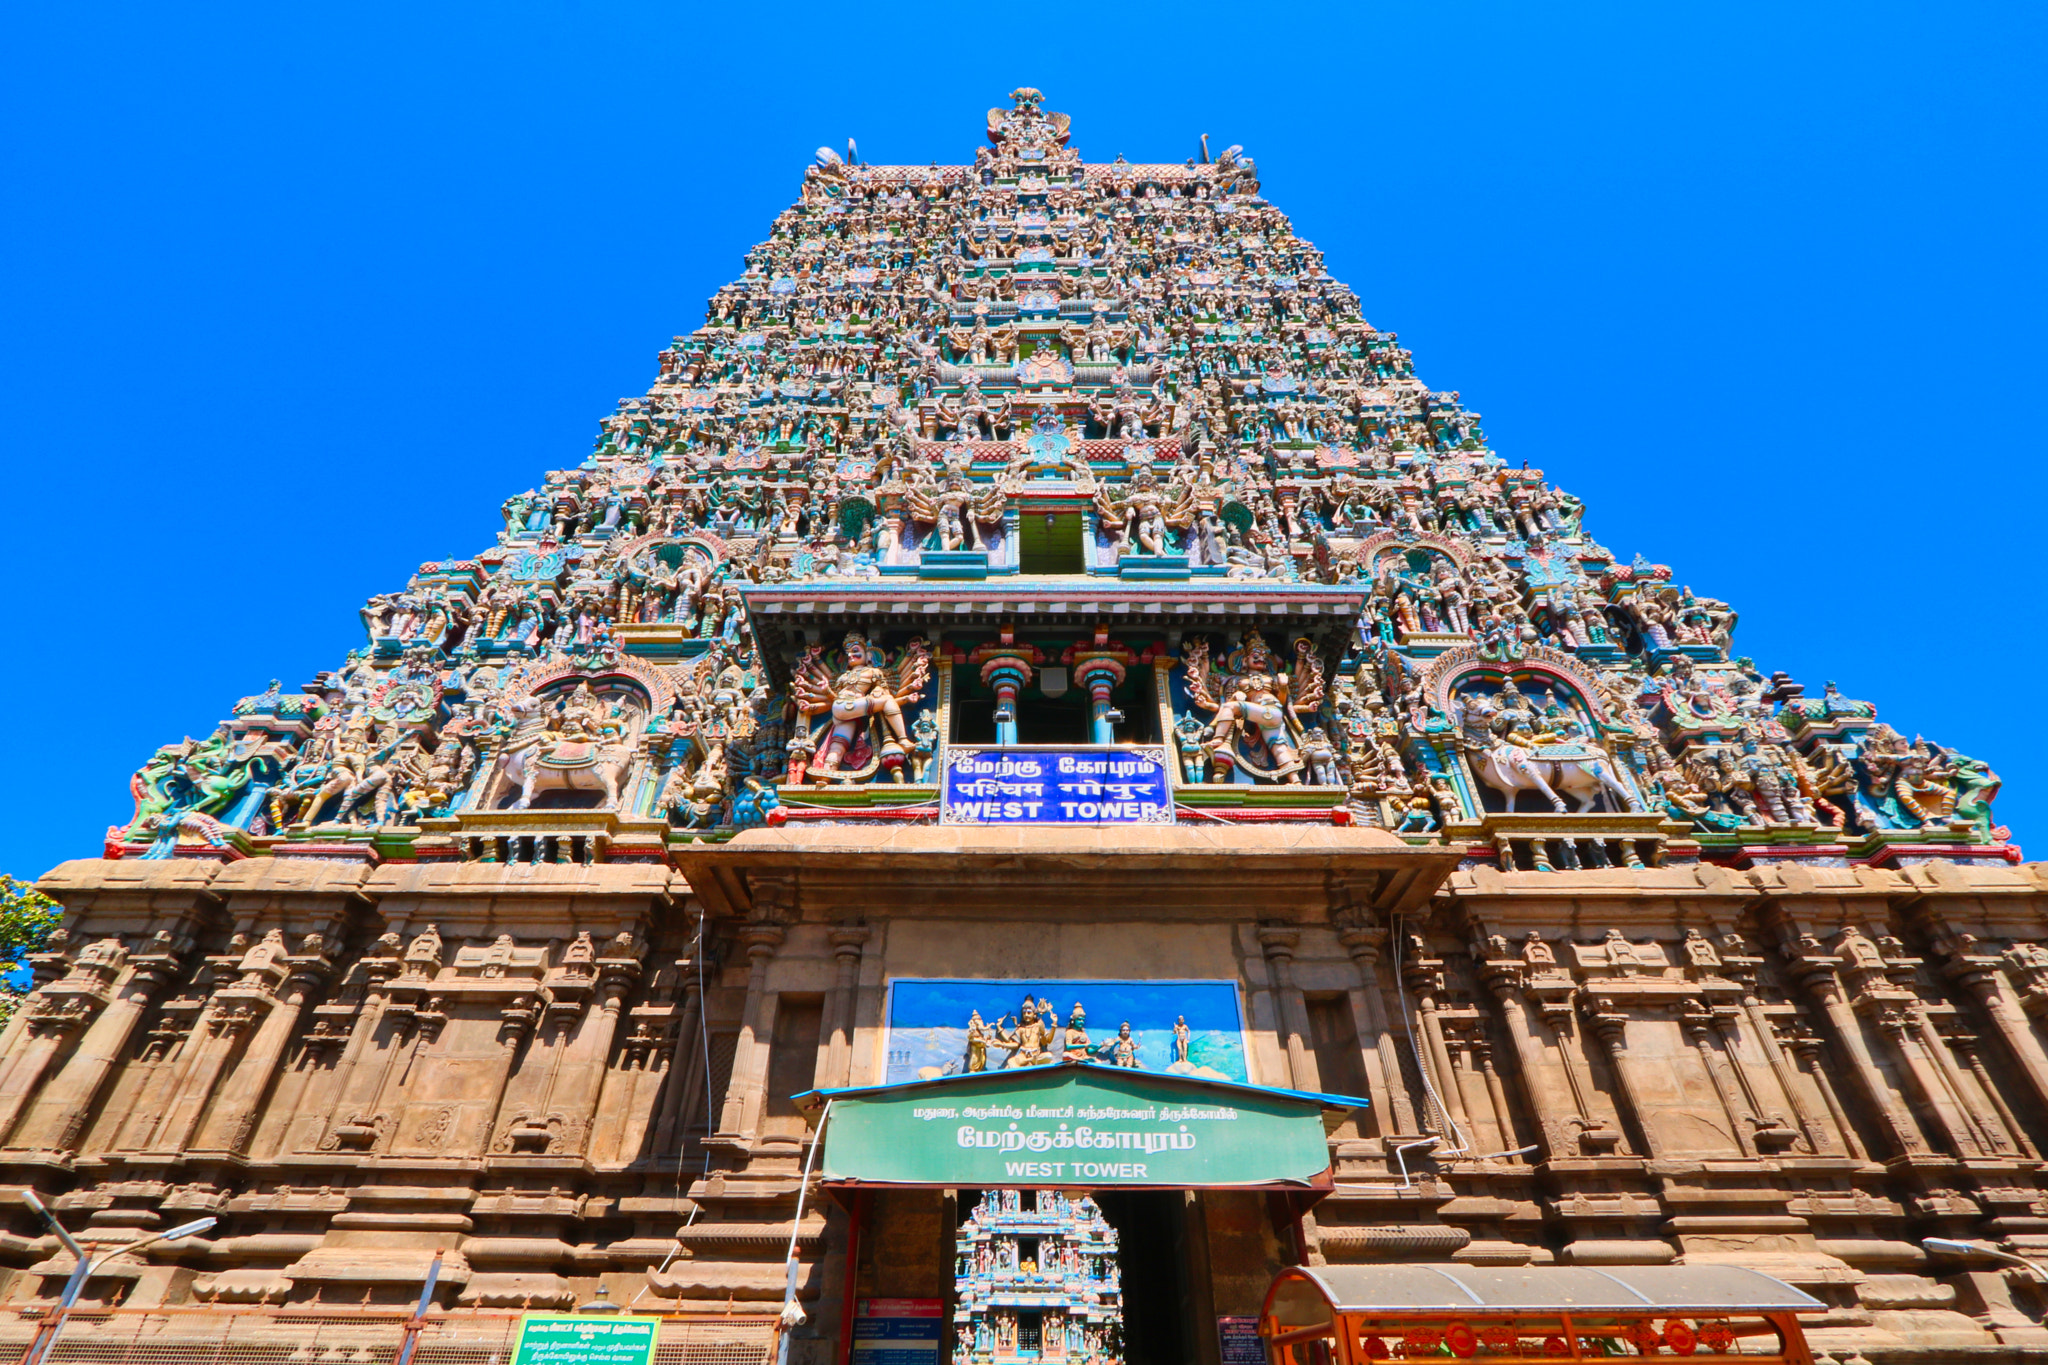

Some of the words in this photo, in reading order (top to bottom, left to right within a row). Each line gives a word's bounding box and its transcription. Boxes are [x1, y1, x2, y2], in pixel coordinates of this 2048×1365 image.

[956, 756, 1042, 777] மேற்கு
[1058, 757, 1155, 778] கோபுரம்
[956, 778, 1044, 797] पश्चिम
[1058, 779, 1156, 800] गोपुर
[954, 802, 1044, 818] WEST
[1061, 802, 1159, 818] TOWER
[913, 1107, 960, 1121] மதுரை,
[962, 1104, 1023, 1120] அருள்மிகு
[1026, 1104, 1074, 1119] மீனாட்சி
[1077, 1105, 1156, 1121] சுந்தரேசுவரர்
[1159, 1107, 1238, 1122] திருக்கோயில்
[957, 1122, 1196, 1155] மேற்குக்கோபுரம்
[1005, 1162, 1066, 1177] WEST
[1071, 1163, 1148, 1178] TOWER
